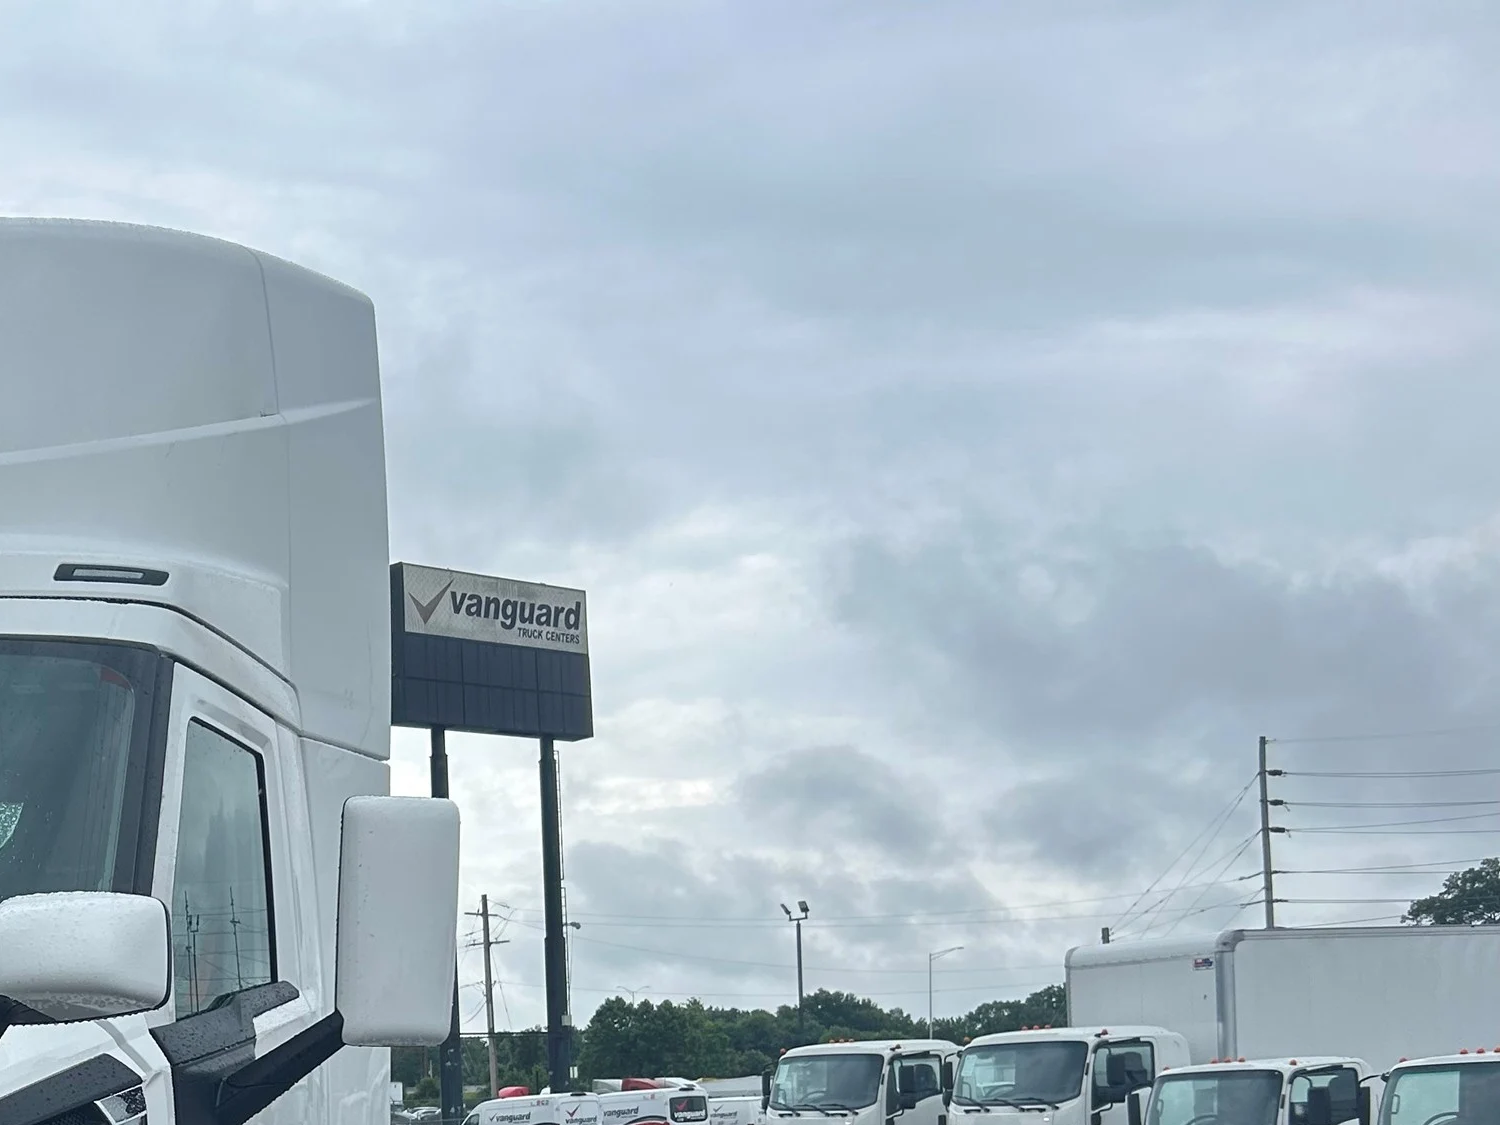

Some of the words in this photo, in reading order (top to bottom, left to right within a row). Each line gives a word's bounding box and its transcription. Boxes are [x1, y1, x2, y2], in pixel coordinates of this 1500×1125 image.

[450, 590, 581, 631] vanguard
[517, 627, 543, 640] TRUCK
[546, 631, 580, 645] CENTERS
[496, 1112, 531, 1123] vanguard
